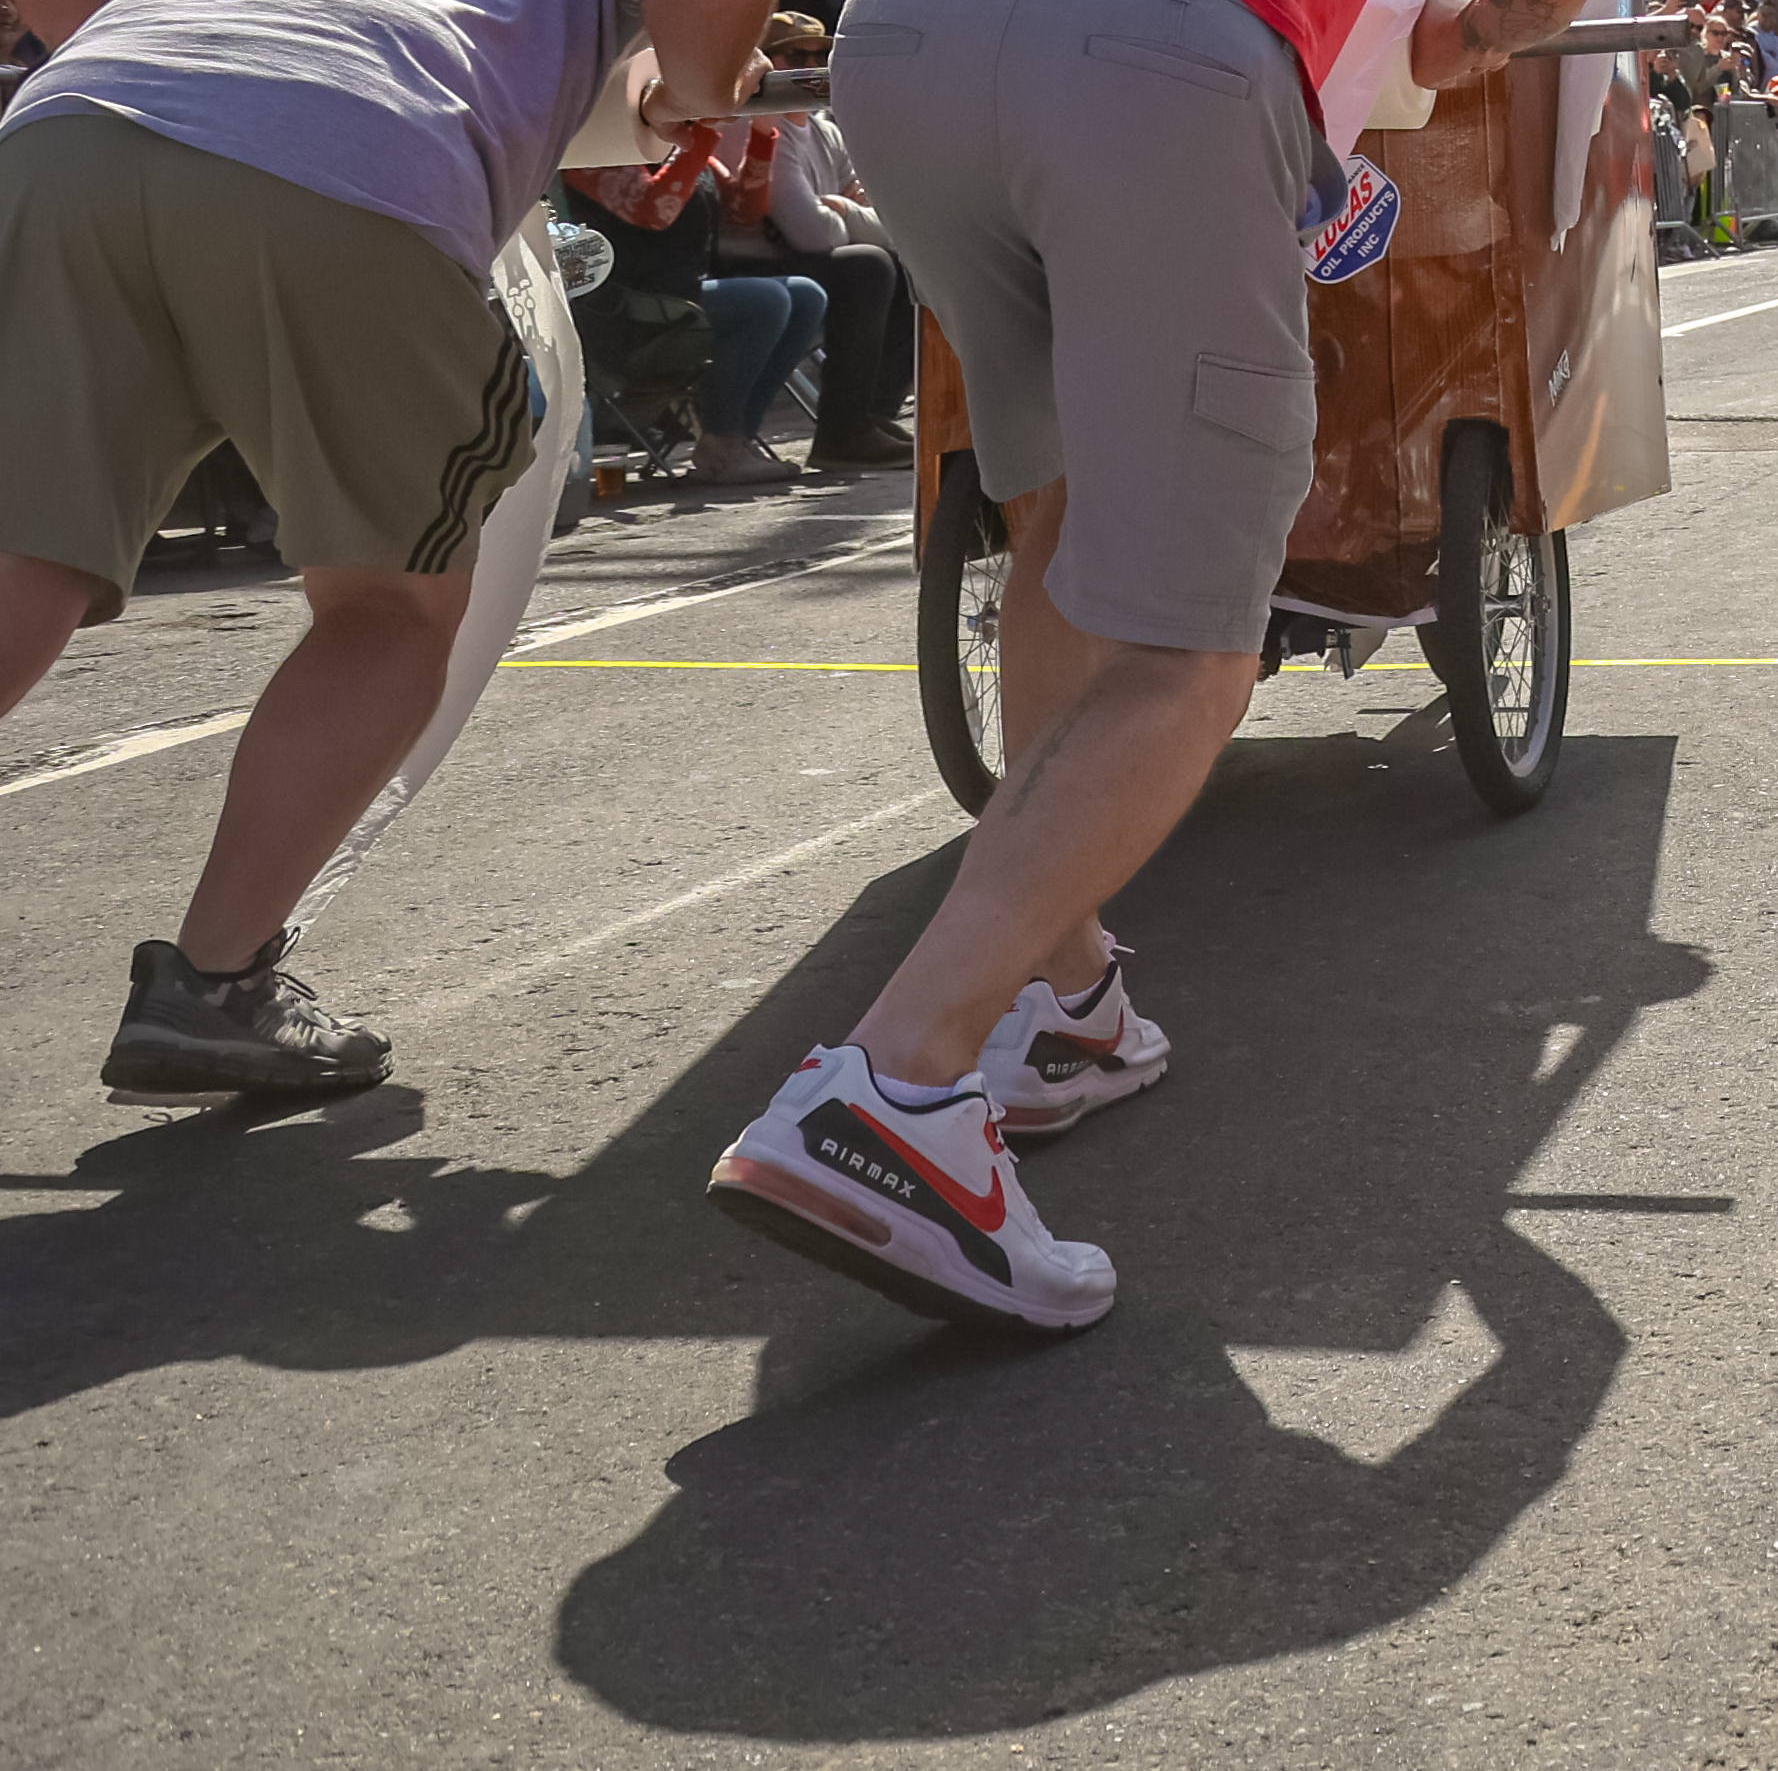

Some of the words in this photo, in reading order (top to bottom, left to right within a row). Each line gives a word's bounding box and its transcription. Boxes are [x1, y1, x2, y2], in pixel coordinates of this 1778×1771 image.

[1320, 256, 1343, 278] OIL
[1338, 189, 1396, 256] PRODUCTS
[1357, 233, 1380, 259] INC
[820, 1136, 917, 1199] AIRMAX
